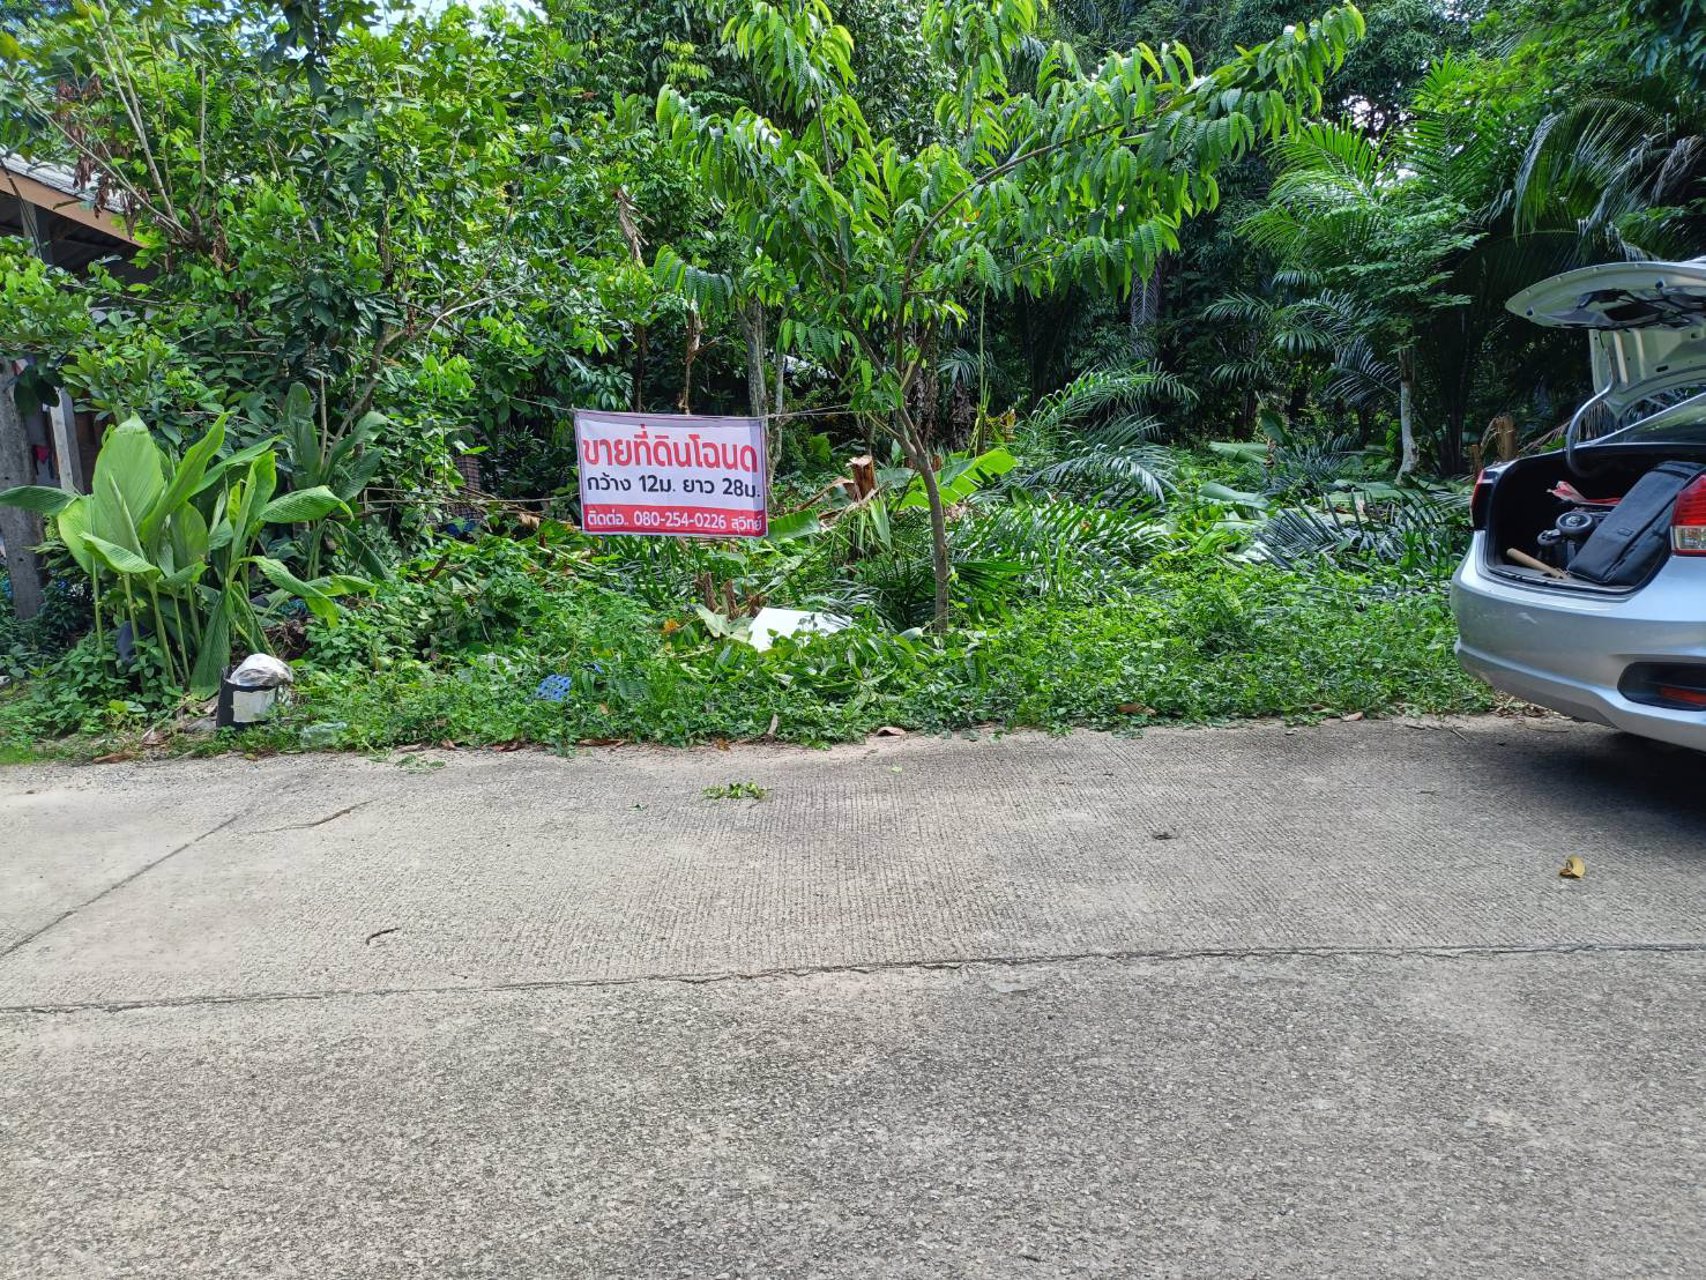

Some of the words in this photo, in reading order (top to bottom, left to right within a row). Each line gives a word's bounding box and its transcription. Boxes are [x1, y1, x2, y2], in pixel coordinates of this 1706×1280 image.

[582, 423, 758, 473] ขายที่ดินโฉนด
[587, 472, 632, 491] กว้าง
[638, 474, 676, 493] 12ม.
[683, 479, 715, 494] ยาว
[722, 477, 761, 498] 28ม.
[633, 510, 727, 529] 080-254-0226
